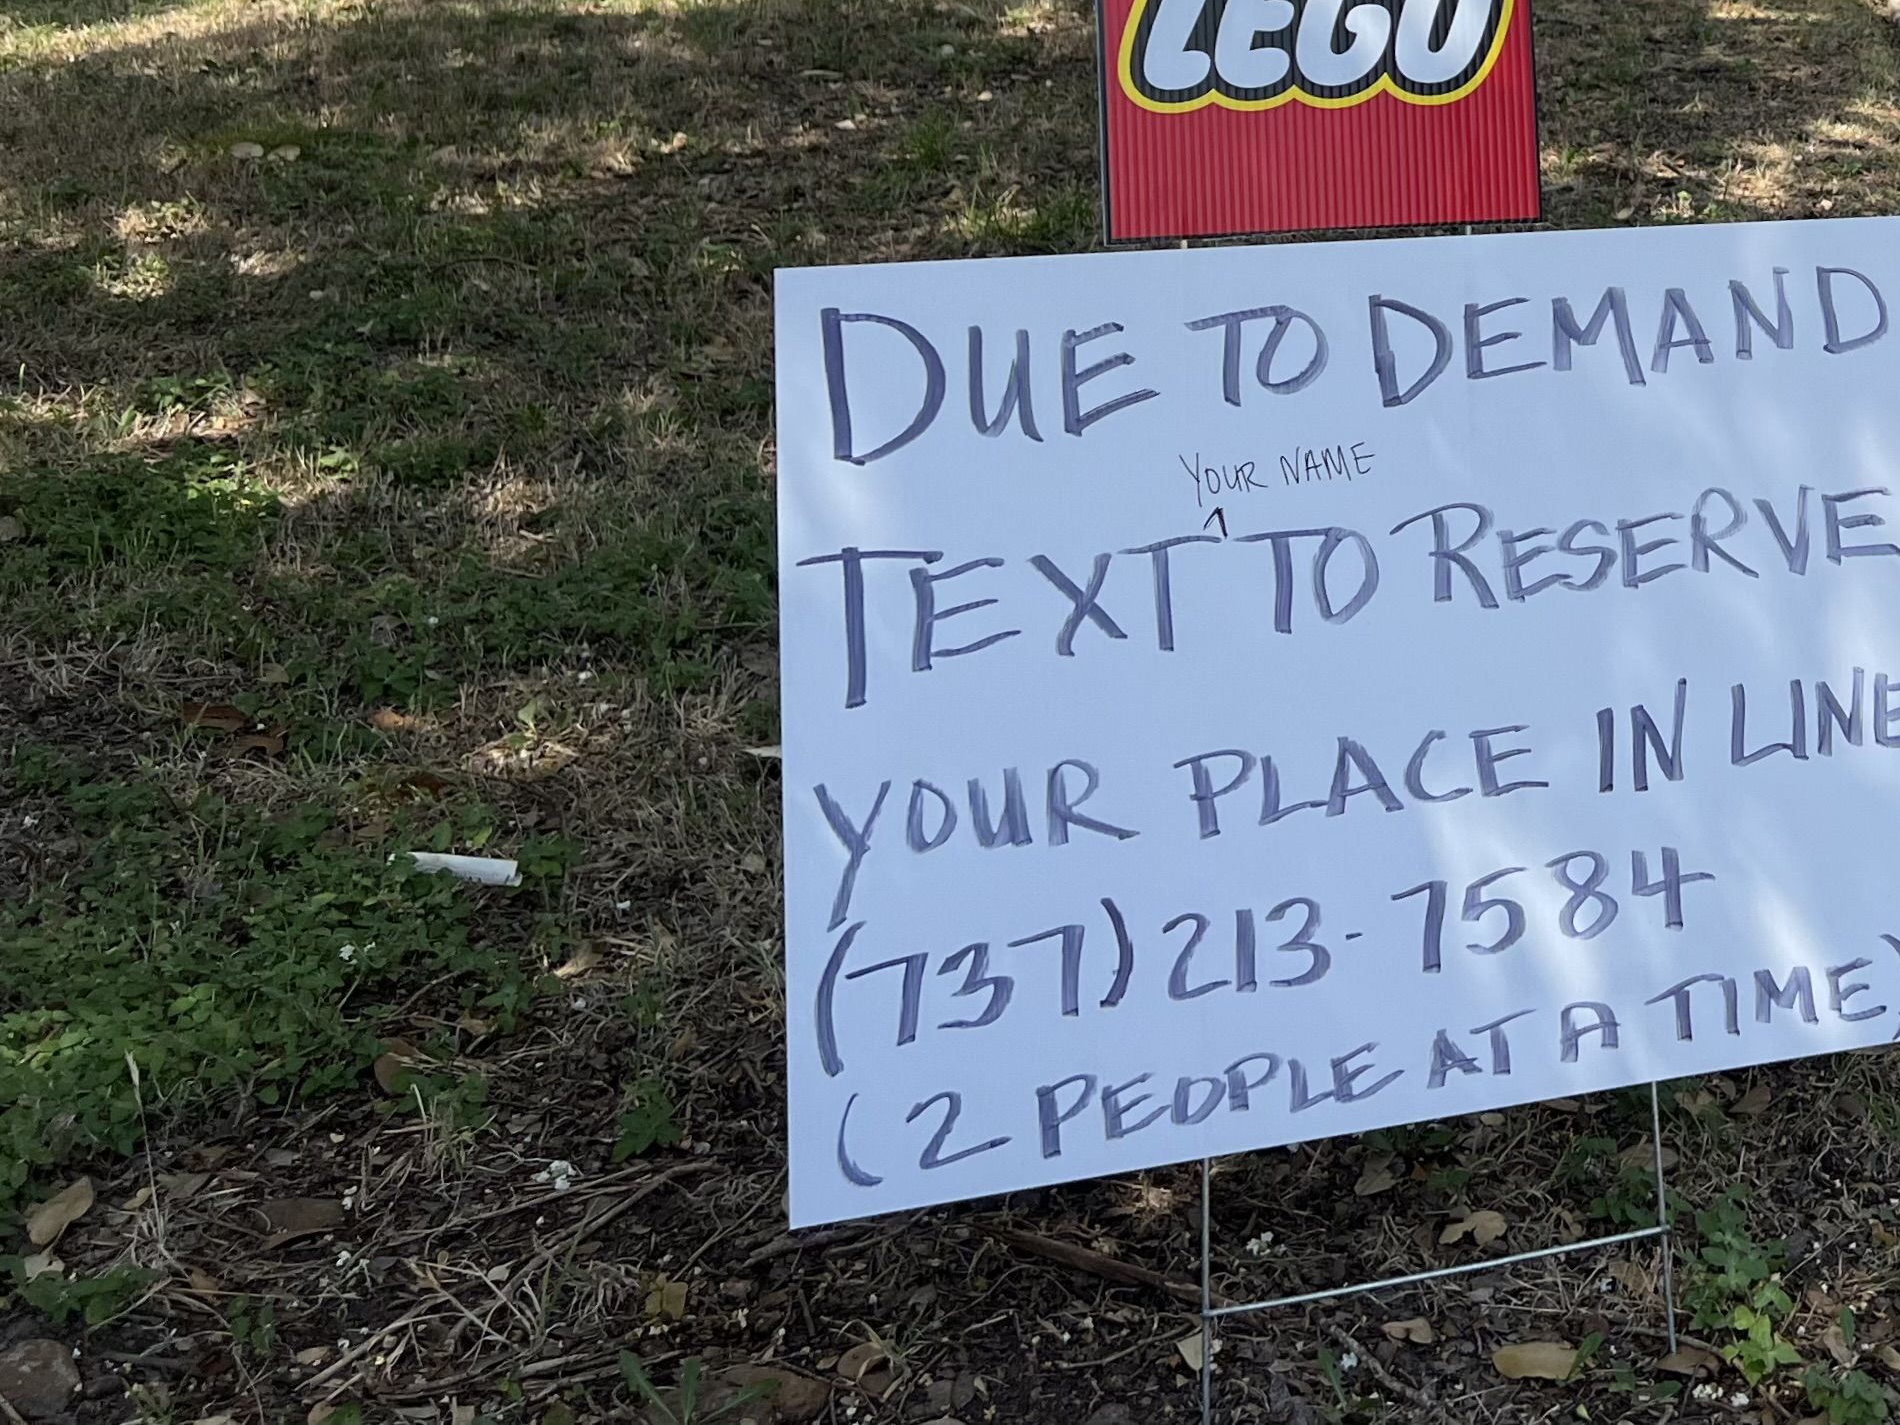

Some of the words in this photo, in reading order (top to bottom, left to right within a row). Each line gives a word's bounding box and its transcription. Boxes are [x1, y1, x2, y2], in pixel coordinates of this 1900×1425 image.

[819, 306, 1161, 466] DUE
[1184, 304, 1330, 407] TO
[1368, 265, 1889, 408] DEMAND
[1178, 452, 1269, 508] YOUR
[1279, 441, 1376, 486] NAME
[795, 534, 1223, 709] TEXT
[1233, 526, 1380, 635] TO
[812, 758, 1141, 933] YOUR
[1172, 724, 1549, 840] PLACE
[1596, 677, 1688, 793] IN
[1035, 1042, 1406, 1160] PEOPLE
[1426, 1008, 1539, 1088] AT
[1559, 1000, 1621, 1063] A
